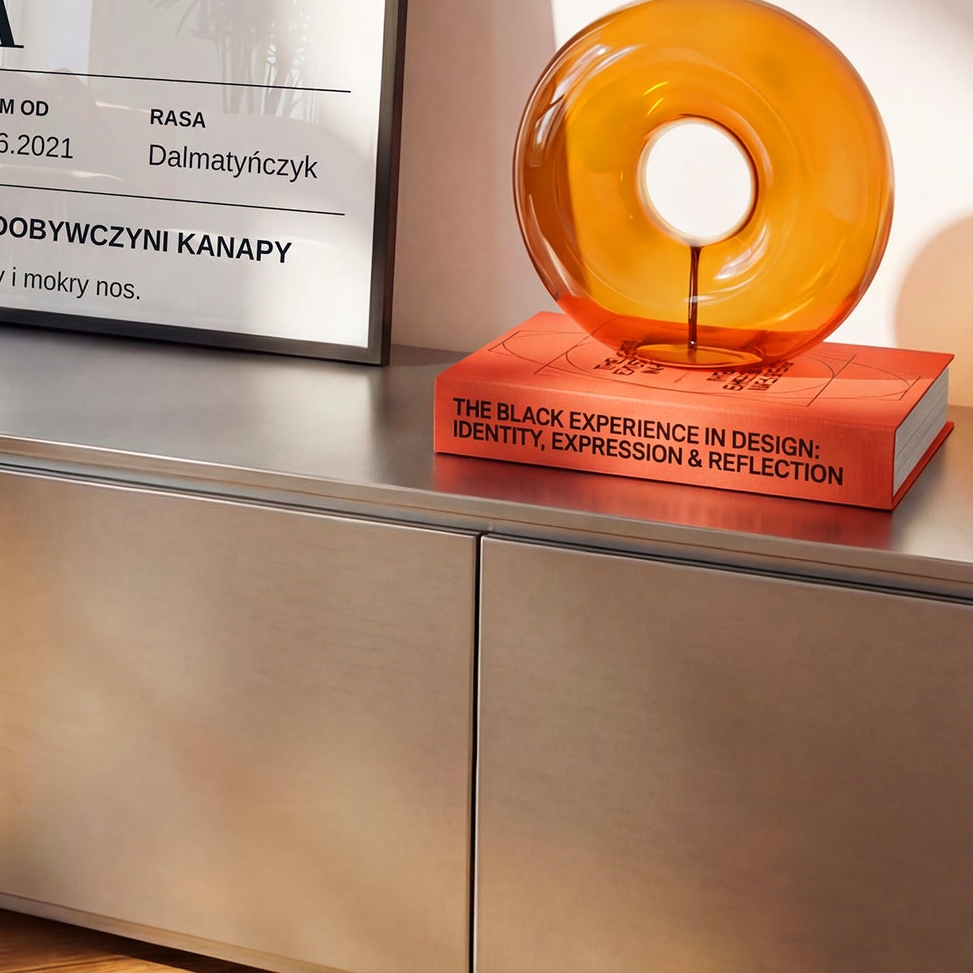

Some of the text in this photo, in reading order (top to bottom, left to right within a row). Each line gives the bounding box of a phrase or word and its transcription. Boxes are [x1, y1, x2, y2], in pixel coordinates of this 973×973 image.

[20, 99, 49, 117] OD
[149, 108, 207, 129] RASA
[148, 143, 319, 184] Dalmatyńczyk
[177, 231, 293, 264] KANAPY
[11, 266, 17, 287] i
[23, 270, 90, 300] mokry
[95, 279, 142, 301] nos.
[453, 397, 821, 460] THE BLACK EXPERIENCE IN DESIGN:
[453, 419, 844, 486] IDENTITY, EXPRESSION & REFLECTION
